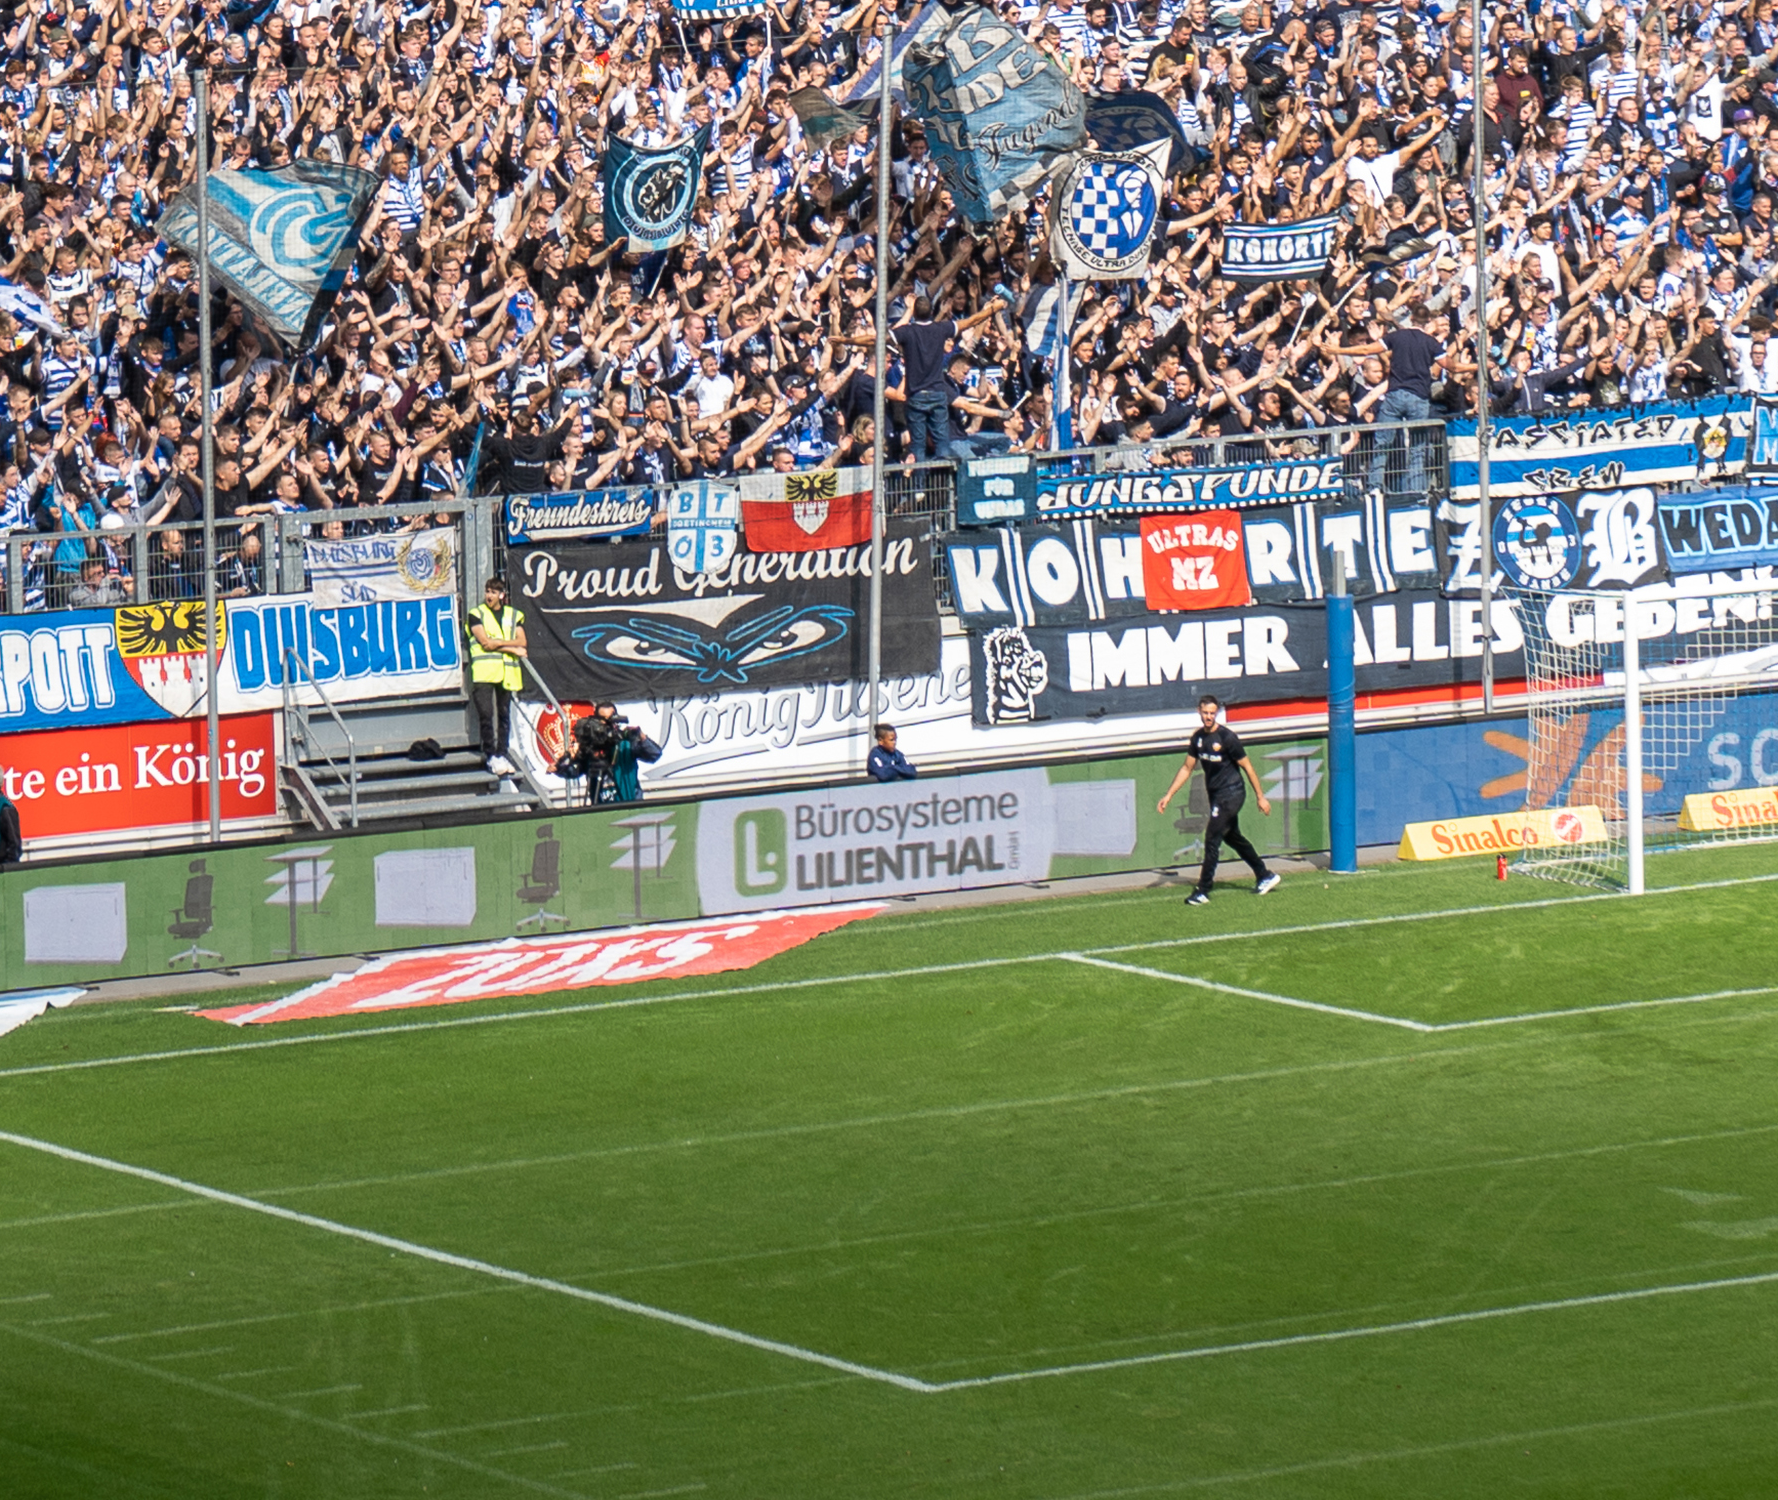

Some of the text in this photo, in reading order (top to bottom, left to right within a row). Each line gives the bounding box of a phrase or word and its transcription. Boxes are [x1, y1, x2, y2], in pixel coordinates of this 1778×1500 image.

[508, 490, 653, 537] Freundeskreis
[1147, 523, 1239, 556] ULTRAS
[523, 546, 663, 601] Proud
[948, 503, 1439, 614] KOHRTE
[1172, 556, 1219, 592] MZ
[228, 594, 459, 694] DUISBURG
[1066, 613, 1300, 693] IMMER
[55, 751, 122, 797] ein
[796, 790, 1020, 846] Bürosysteme
[1430, 815, 1539, 859] Sinalco
[796, 833, 1007, 892] LILIENTHAL
